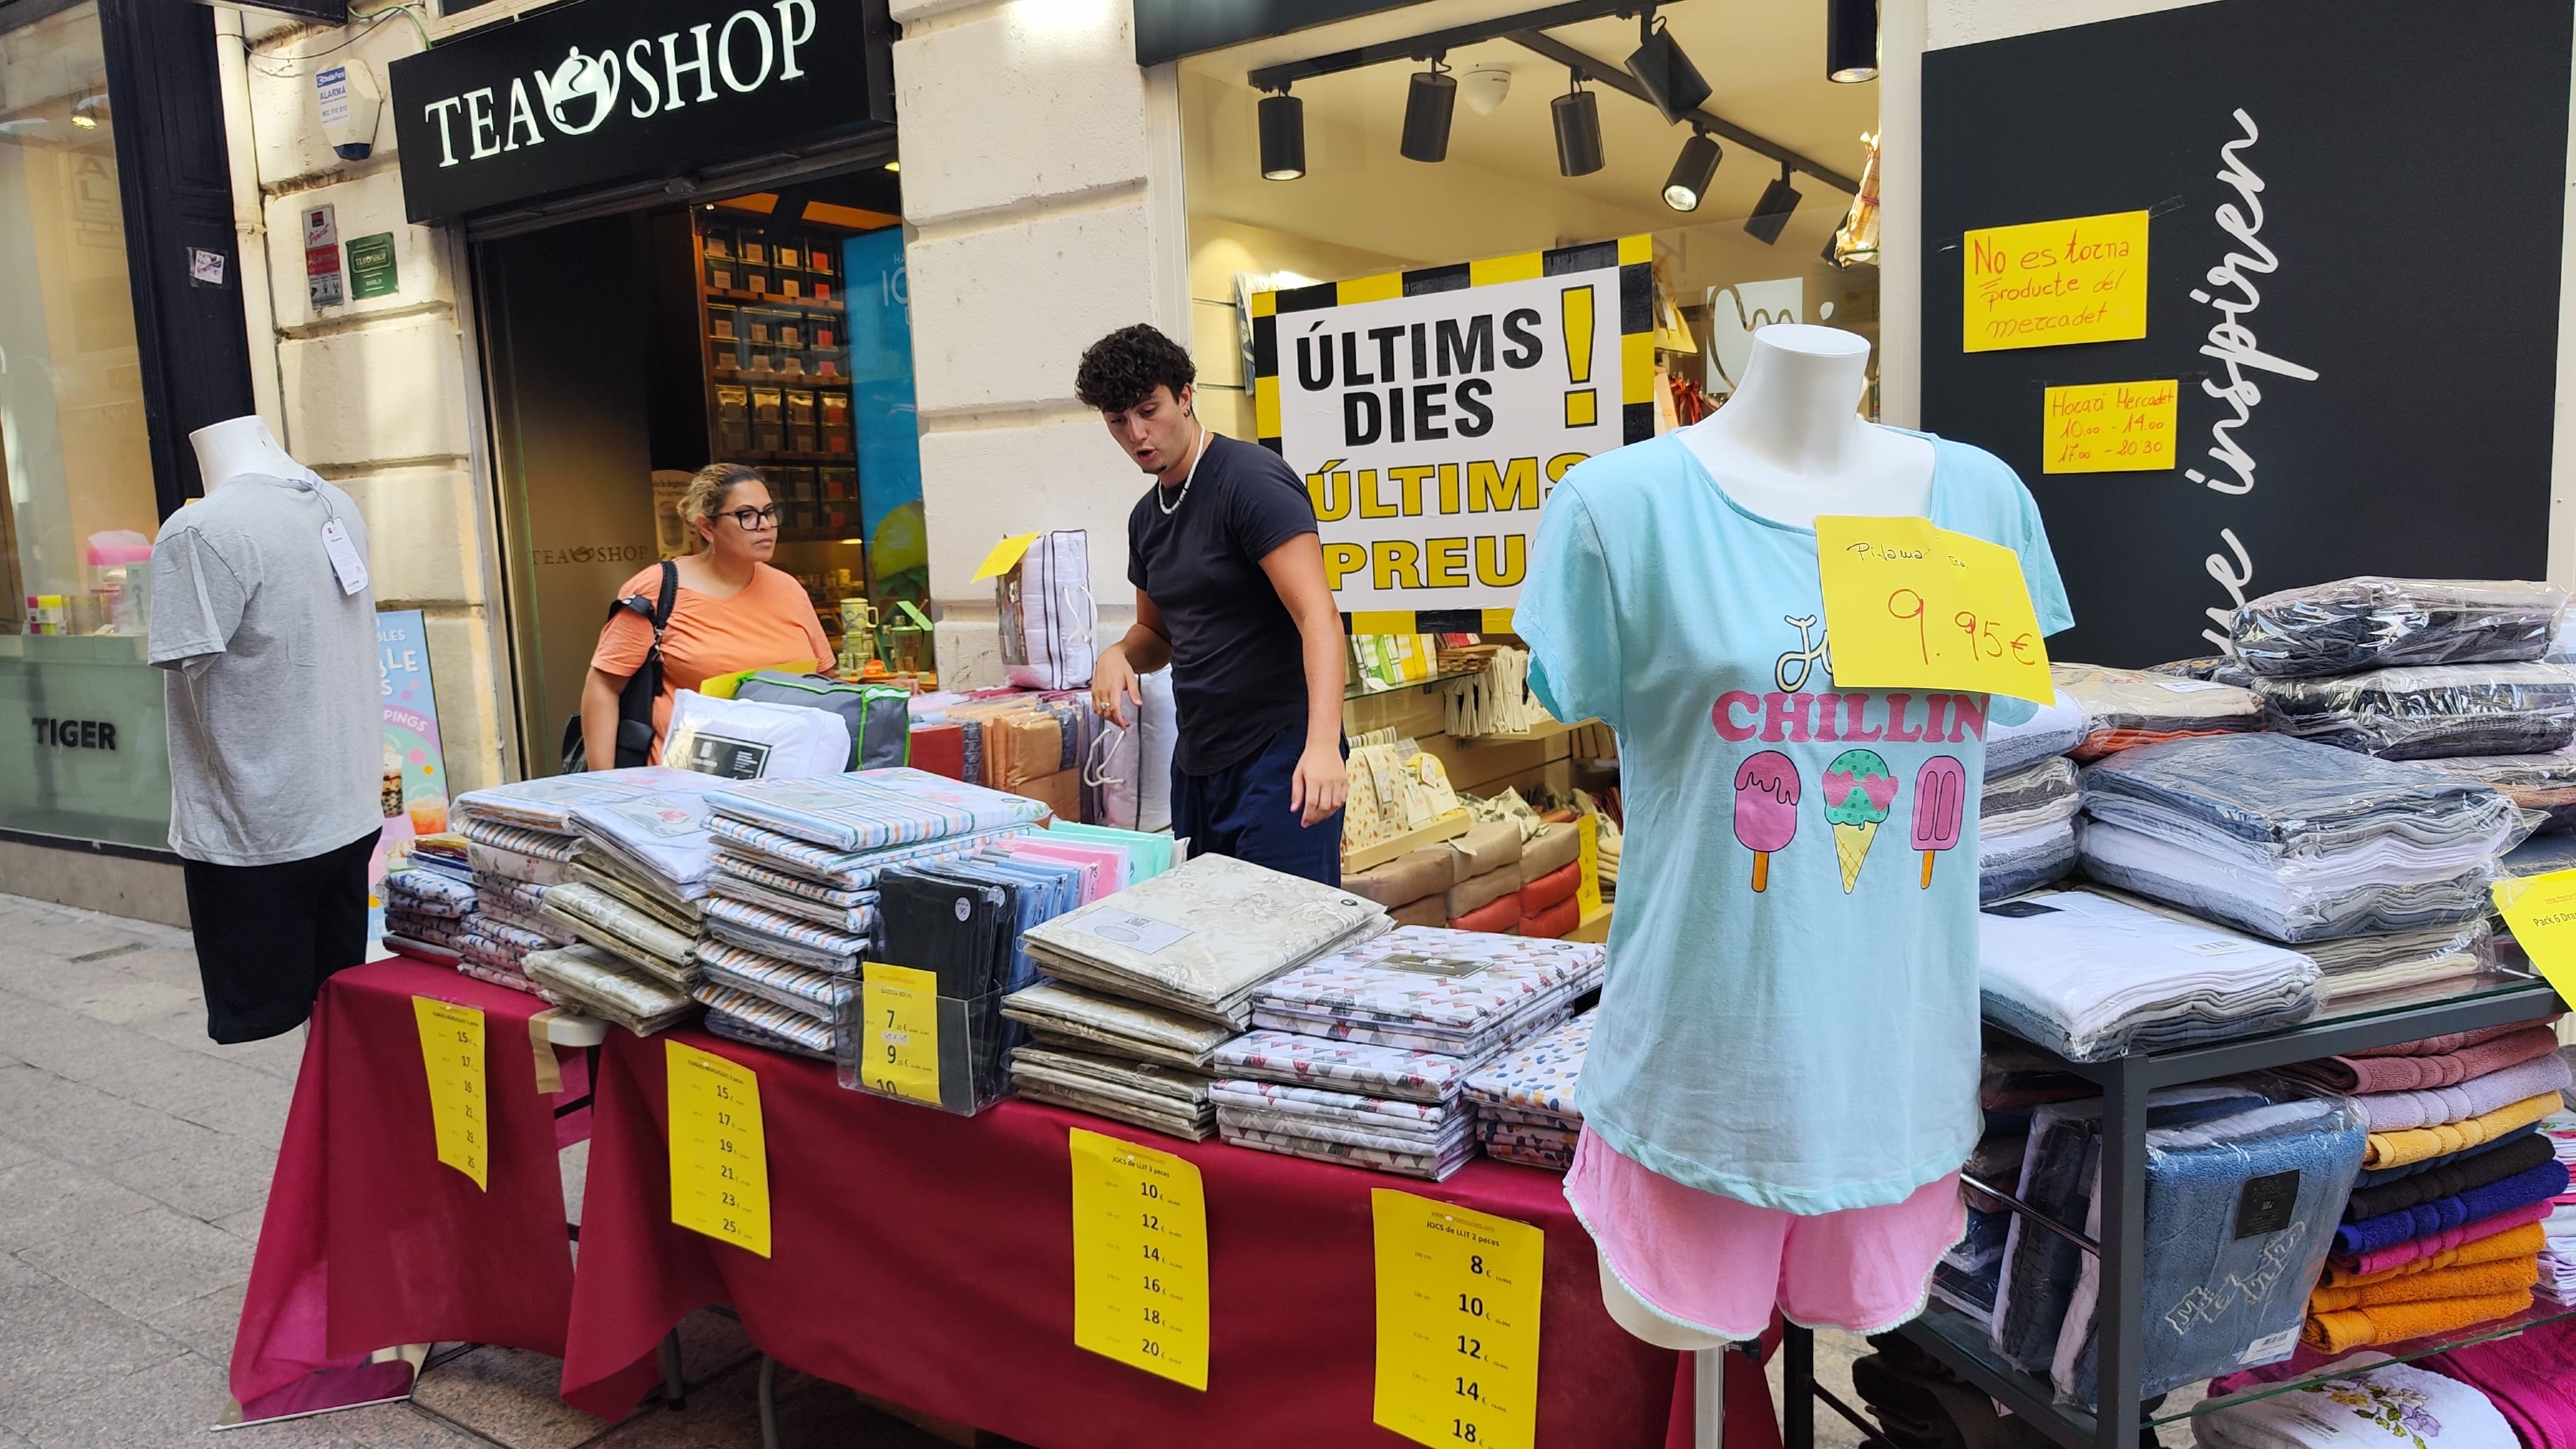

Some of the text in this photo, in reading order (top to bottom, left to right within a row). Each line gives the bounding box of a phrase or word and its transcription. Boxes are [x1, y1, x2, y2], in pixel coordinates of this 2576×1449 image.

[319, 86, 347, 101] ALARMA
[425, 0, 816, 169] TEA SHOP
[1974, 235, 2006, 275] No
[2020, 248, 2057, 270] es
[1979, 271, 2080, 313] producte
[2185, 108, 2319, 496] inspiren
[1985, 301, 2107, 340] mercadet
[1296, 308, 1544, 392] ÚLTIMS
[1343, 378, 1495, 447] DIES
[2053, 391, 2106, 418] Horari
[531, 545, 648, 565] TEA SHOP
[1319, 533, 1532, 592] PREU
[1711, 691, 1989, 743] CHILLIN
[31, 717, 116, 750] TIGER
[2533, 913, 2576, 927] Pack 6 Dra
[887, 1009, 896, 1029] 7
[457, 1031, 469, 1043] 15
[462, 1055, 470, 1067] 17
[887, 1045, 896, 1064] 9
[716, 1084, 728, 1099] 15
[718, 1112, 730, 1125] 17
[720, 1138, 733, 1153] 19
[721, 1165, 735, 1180] 21
[1113, 1156, 1126, 1165] JOCS
[1136, 1162, 1148, 1171] LLIT
[1153, 1169, 1170, 1178] peces
[722, 1191, 735, 1206] 23
[1140, 1182, 1158, 1199] 10
[723, 1218, 736, 1233] 25
[1141, 1214, 1159, 1231] 12
[1426, 1221, 1444, 1231] JOCS
[1445, 1226, 1455, 1234] de
[1456, 1229, 1470, 1239] LLIT
[1471, 1233, 1477, 1241] 2
[1478, 1236, 1500, 1247] peces
[1143, 1245, 1160, 1262] 14
[1470, 1255, 1484, 1275] 8
[1143, 1275, 1160, 1293] 16
[1458, 1293, 1484, 1317] 10
[1143, 1307, 1160, 1324] 18
[1142, 1338, 1160, 1357] 20
[1457, 1335, 1481, 1360] 12
[1455, 1377, 1479, 1401] 14
[1452, 1418, 1477, 1443] 18
